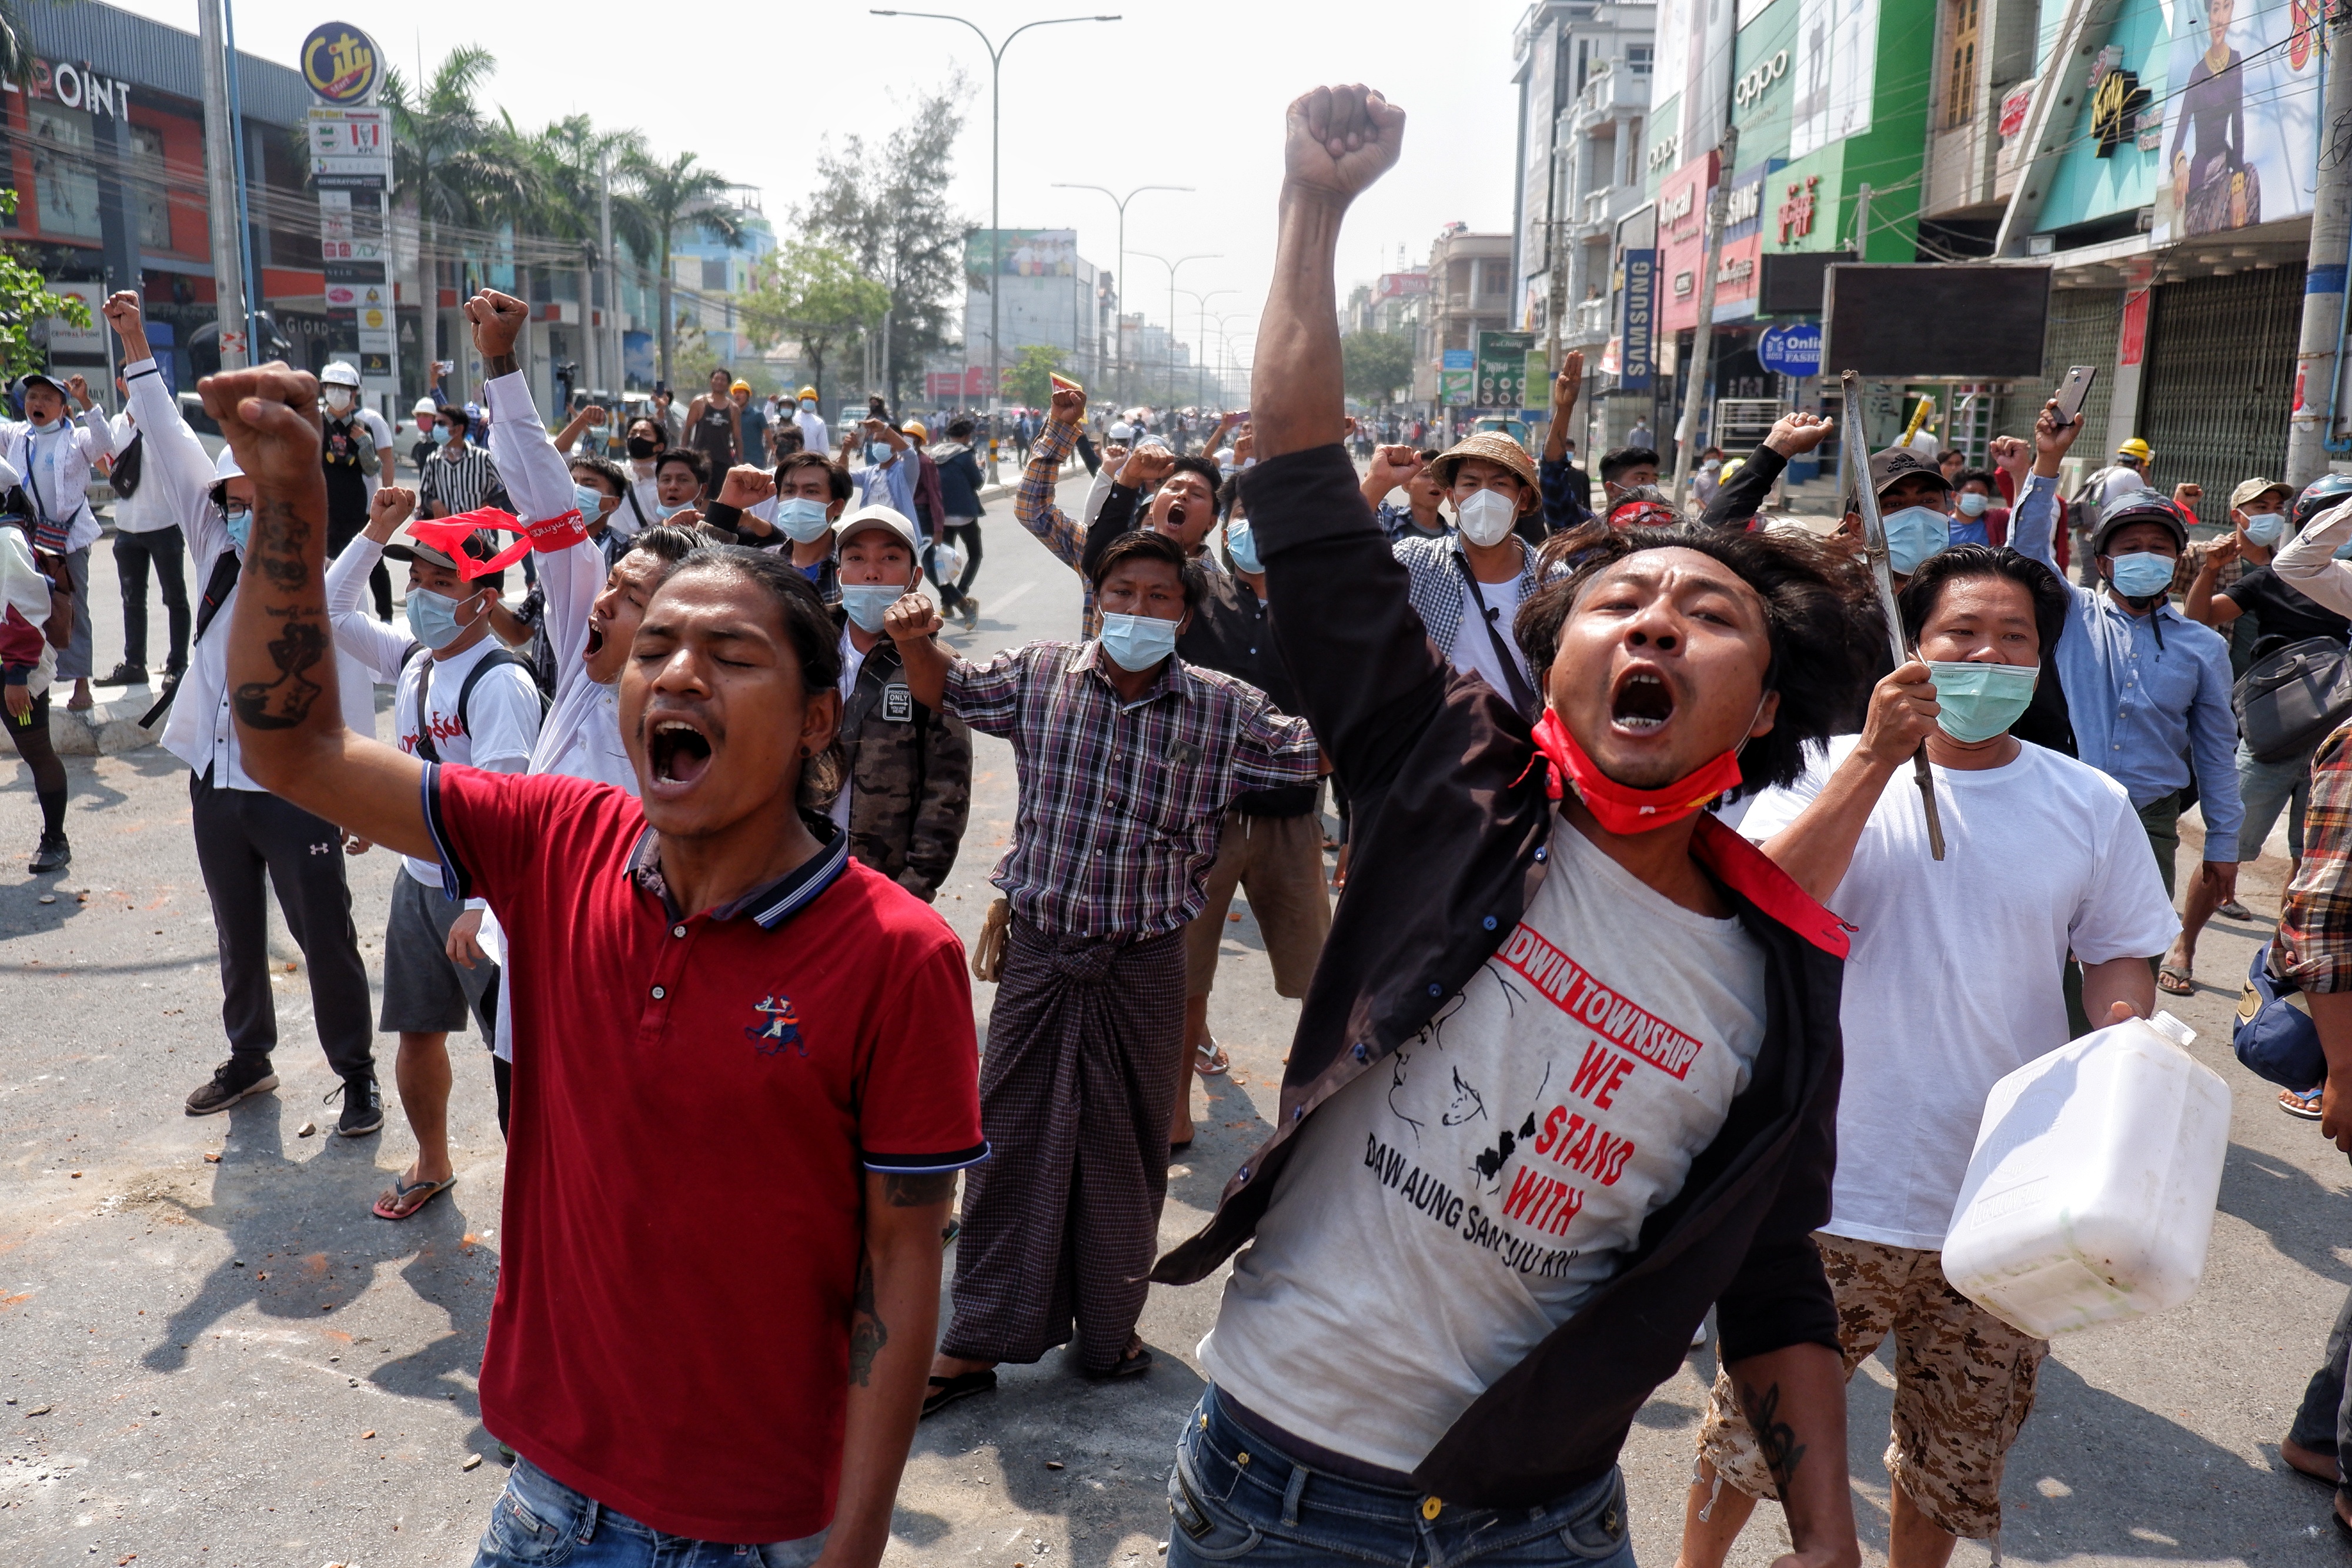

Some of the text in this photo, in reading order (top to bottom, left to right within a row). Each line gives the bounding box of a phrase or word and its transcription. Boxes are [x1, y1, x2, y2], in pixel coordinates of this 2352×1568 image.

[28, 58, 130, 122] POINT
[305, 32, 372, 98] City
[1736, 49, 1788, 109] oppo
[1628, 261, 1650, 377] SAMSUNG
[1787, 337, 1822, 350] Onli
[88, 389, 105, 400] AILY
[1886, 457, 1923, 473] adidas
[1571, 977, 1698, 1074] TOWNSHIP
[1569, 1039, 1636, 1111] WE
[1535, 1105, 1635, 1186] STAND
[1364, 1132, 1406, 1188] DAW
[1401, 1166, 1464, 1230] AUNG
[1463, 1205, 1505, 1252] SAN
[1502, 1165, 1585, 1236] WITH
